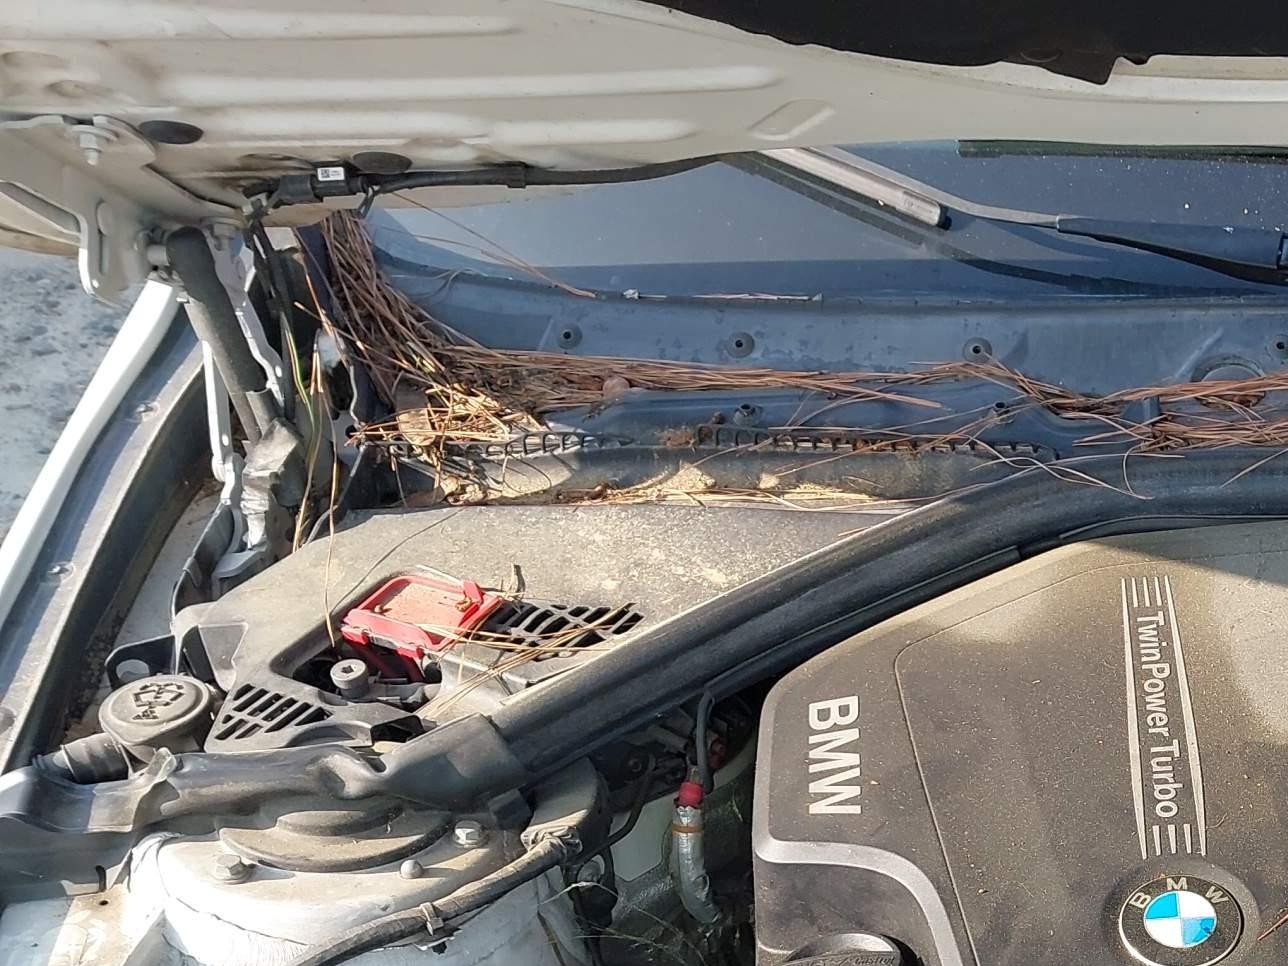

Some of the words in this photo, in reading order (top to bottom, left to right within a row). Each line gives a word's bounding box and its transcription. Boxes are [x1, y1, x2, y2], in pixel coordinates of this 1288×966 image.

[1136, 611, 1171, 738] TwinPower
[808, 695, 861, 814] BMW
[1150, 739, 1184, 818] Turbo
